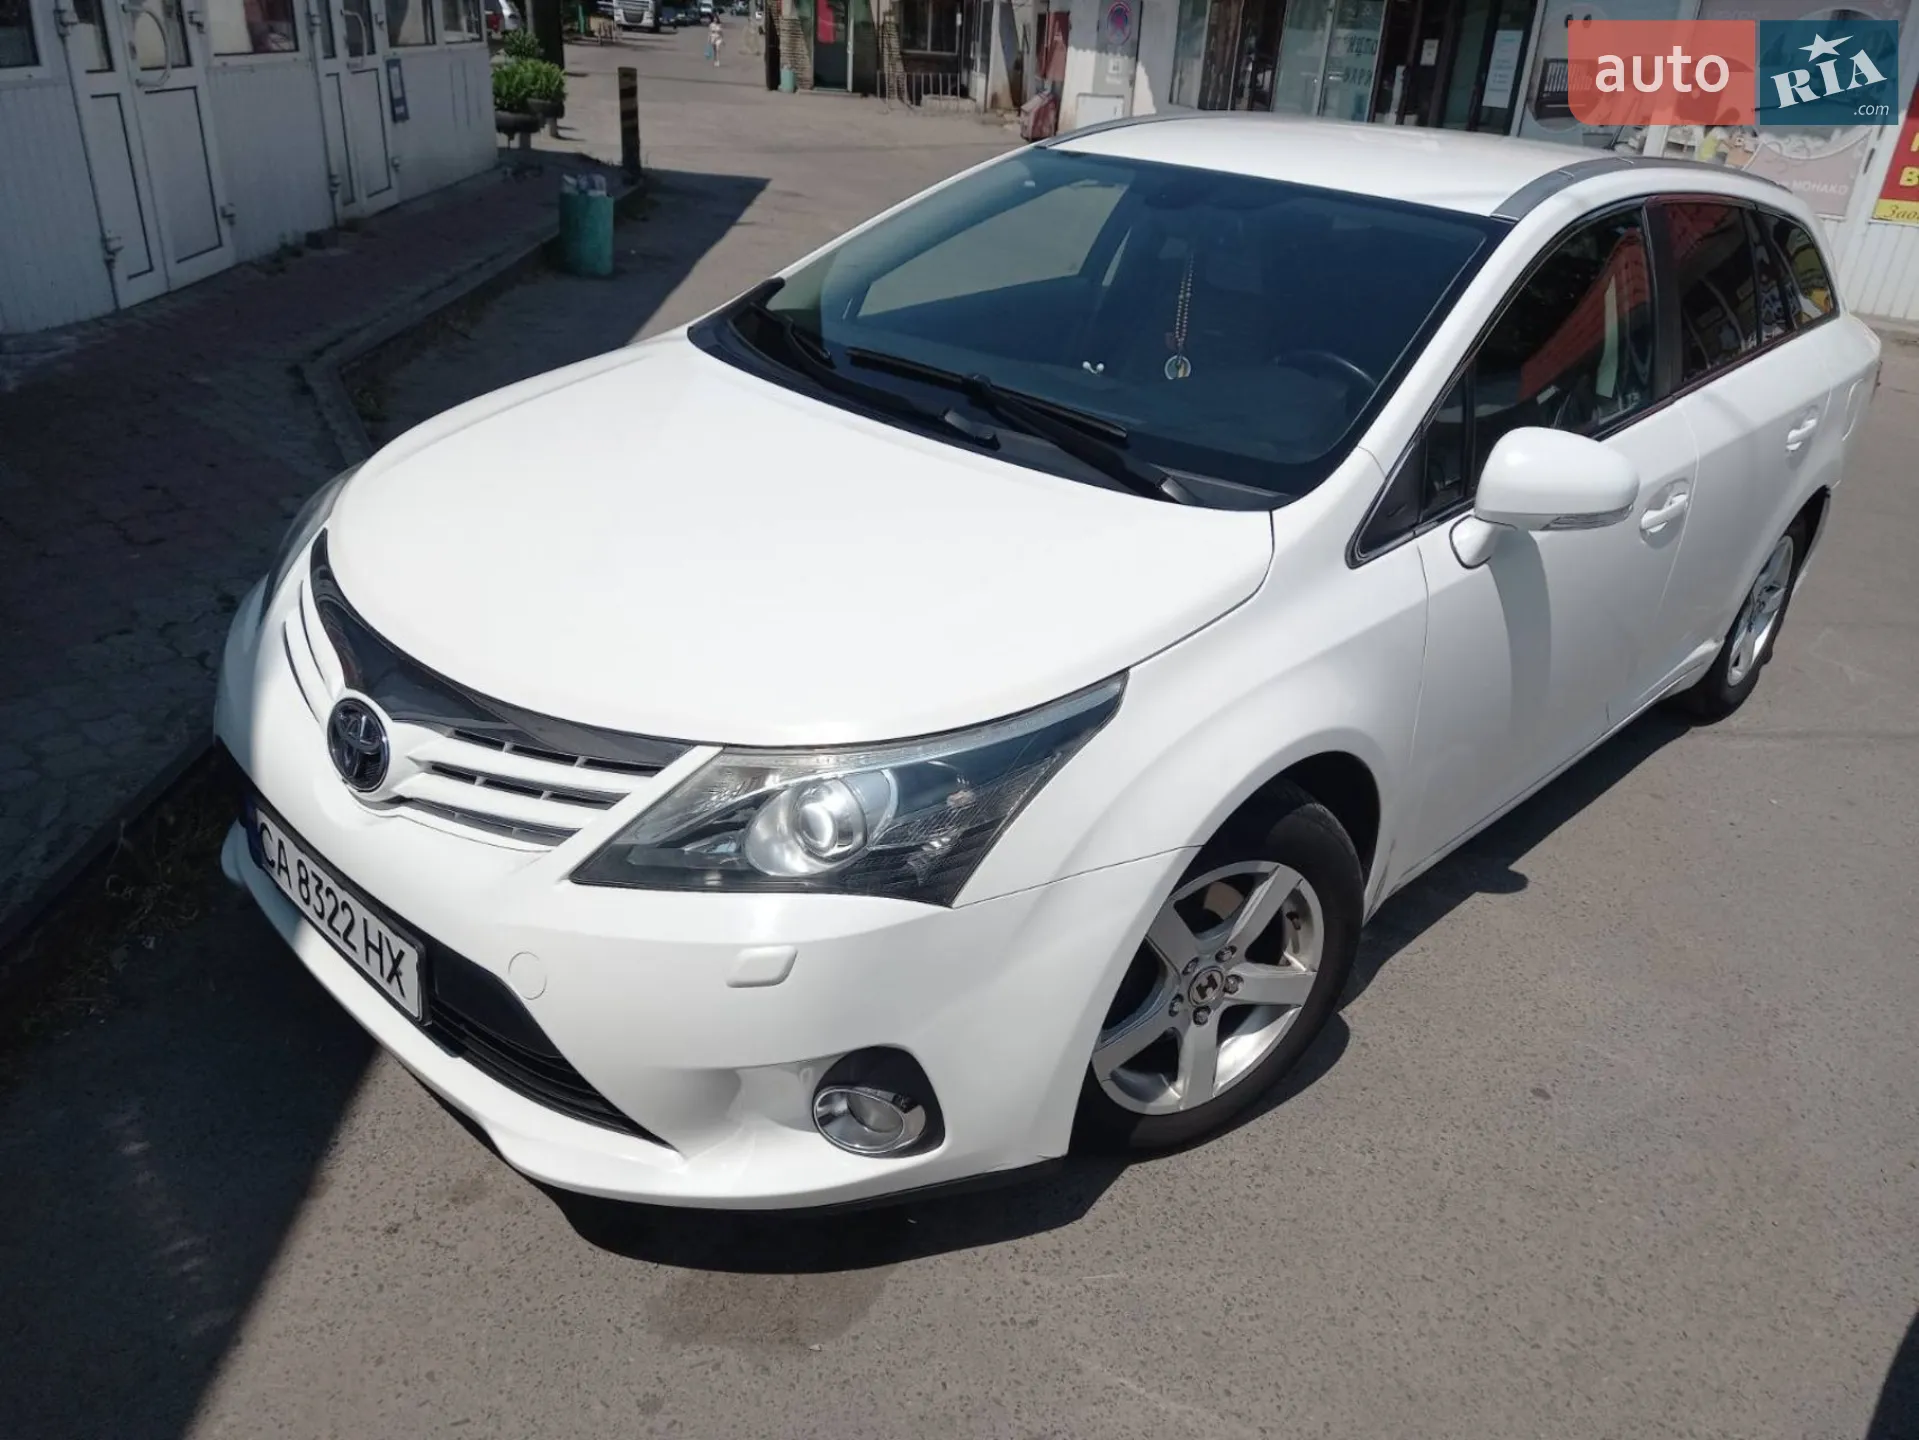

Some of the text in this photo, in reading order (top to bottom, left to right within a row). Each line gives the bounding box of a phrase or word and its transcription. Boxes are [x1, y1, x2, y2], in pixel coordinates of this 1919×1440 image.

[260, 822, 406, 998] CA 8322 HX
